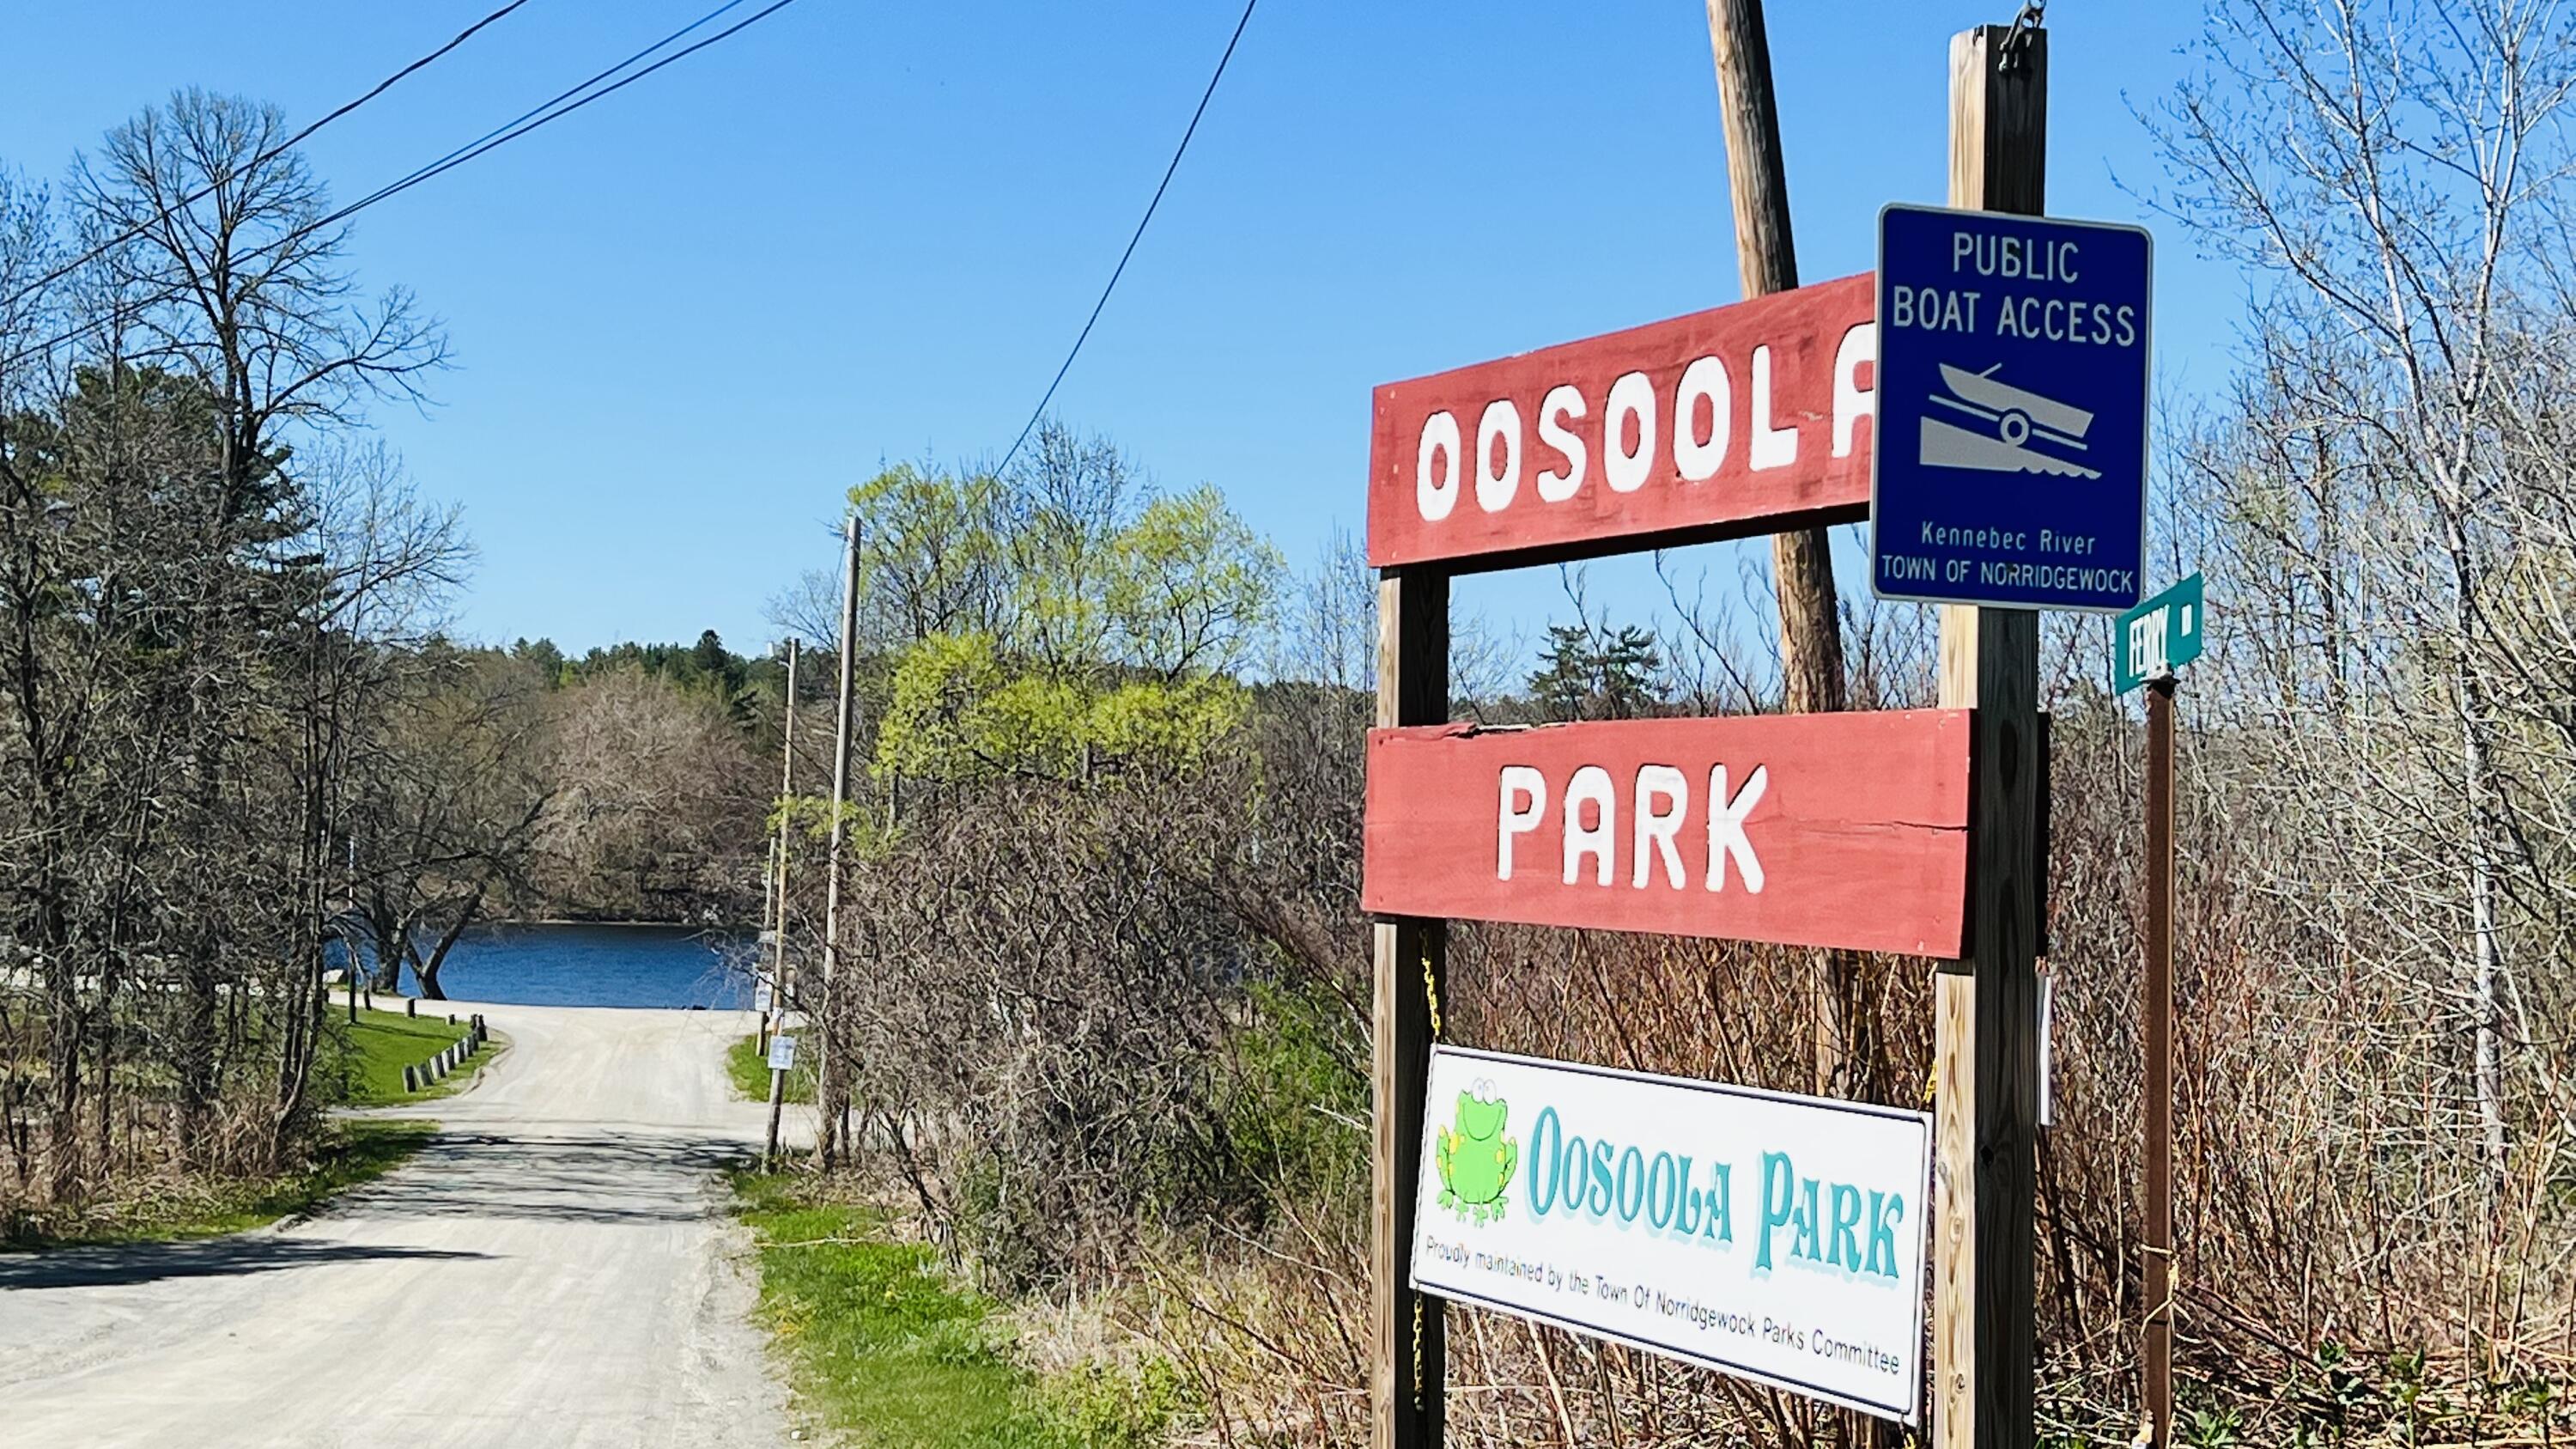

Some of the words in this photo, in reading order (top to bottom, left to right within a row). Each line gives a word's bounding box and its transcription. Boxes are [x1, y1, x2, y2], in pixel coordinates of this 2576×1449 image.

[1953, 232, 2079, 283] PUBLIC
[1893, 285, 1980, 333] BOAT
[1996, 295, 2135, 347] ACCESS
[1921, 521, 2026, 551] Kennebec
[2040, 529, 2096, 555] River
[1882, 555, 1936, 581] TOWN
[1946, 560, 1971, 582] OF
[1980, 562, 2134, 594] NORRIDGEWOCK
[1497, 763, 1768, 894] PARK
[1425, 1234, 1470, 1269] Proudly
[1474, 1251, 1544, 1282] maintained
[1547, 1263, 1564, 1294] by
[1569, 1270, 1589, 1295] the
[1595, 1275, 1628, 1305] Town
[1633, 1284, 1650, 1309] Of
[1656, 1289, 1755, 1338] Norridgewock
[1762, 1316, 1805, 1352] Parks
[1812, 1328, 1900, 1376] Committee
